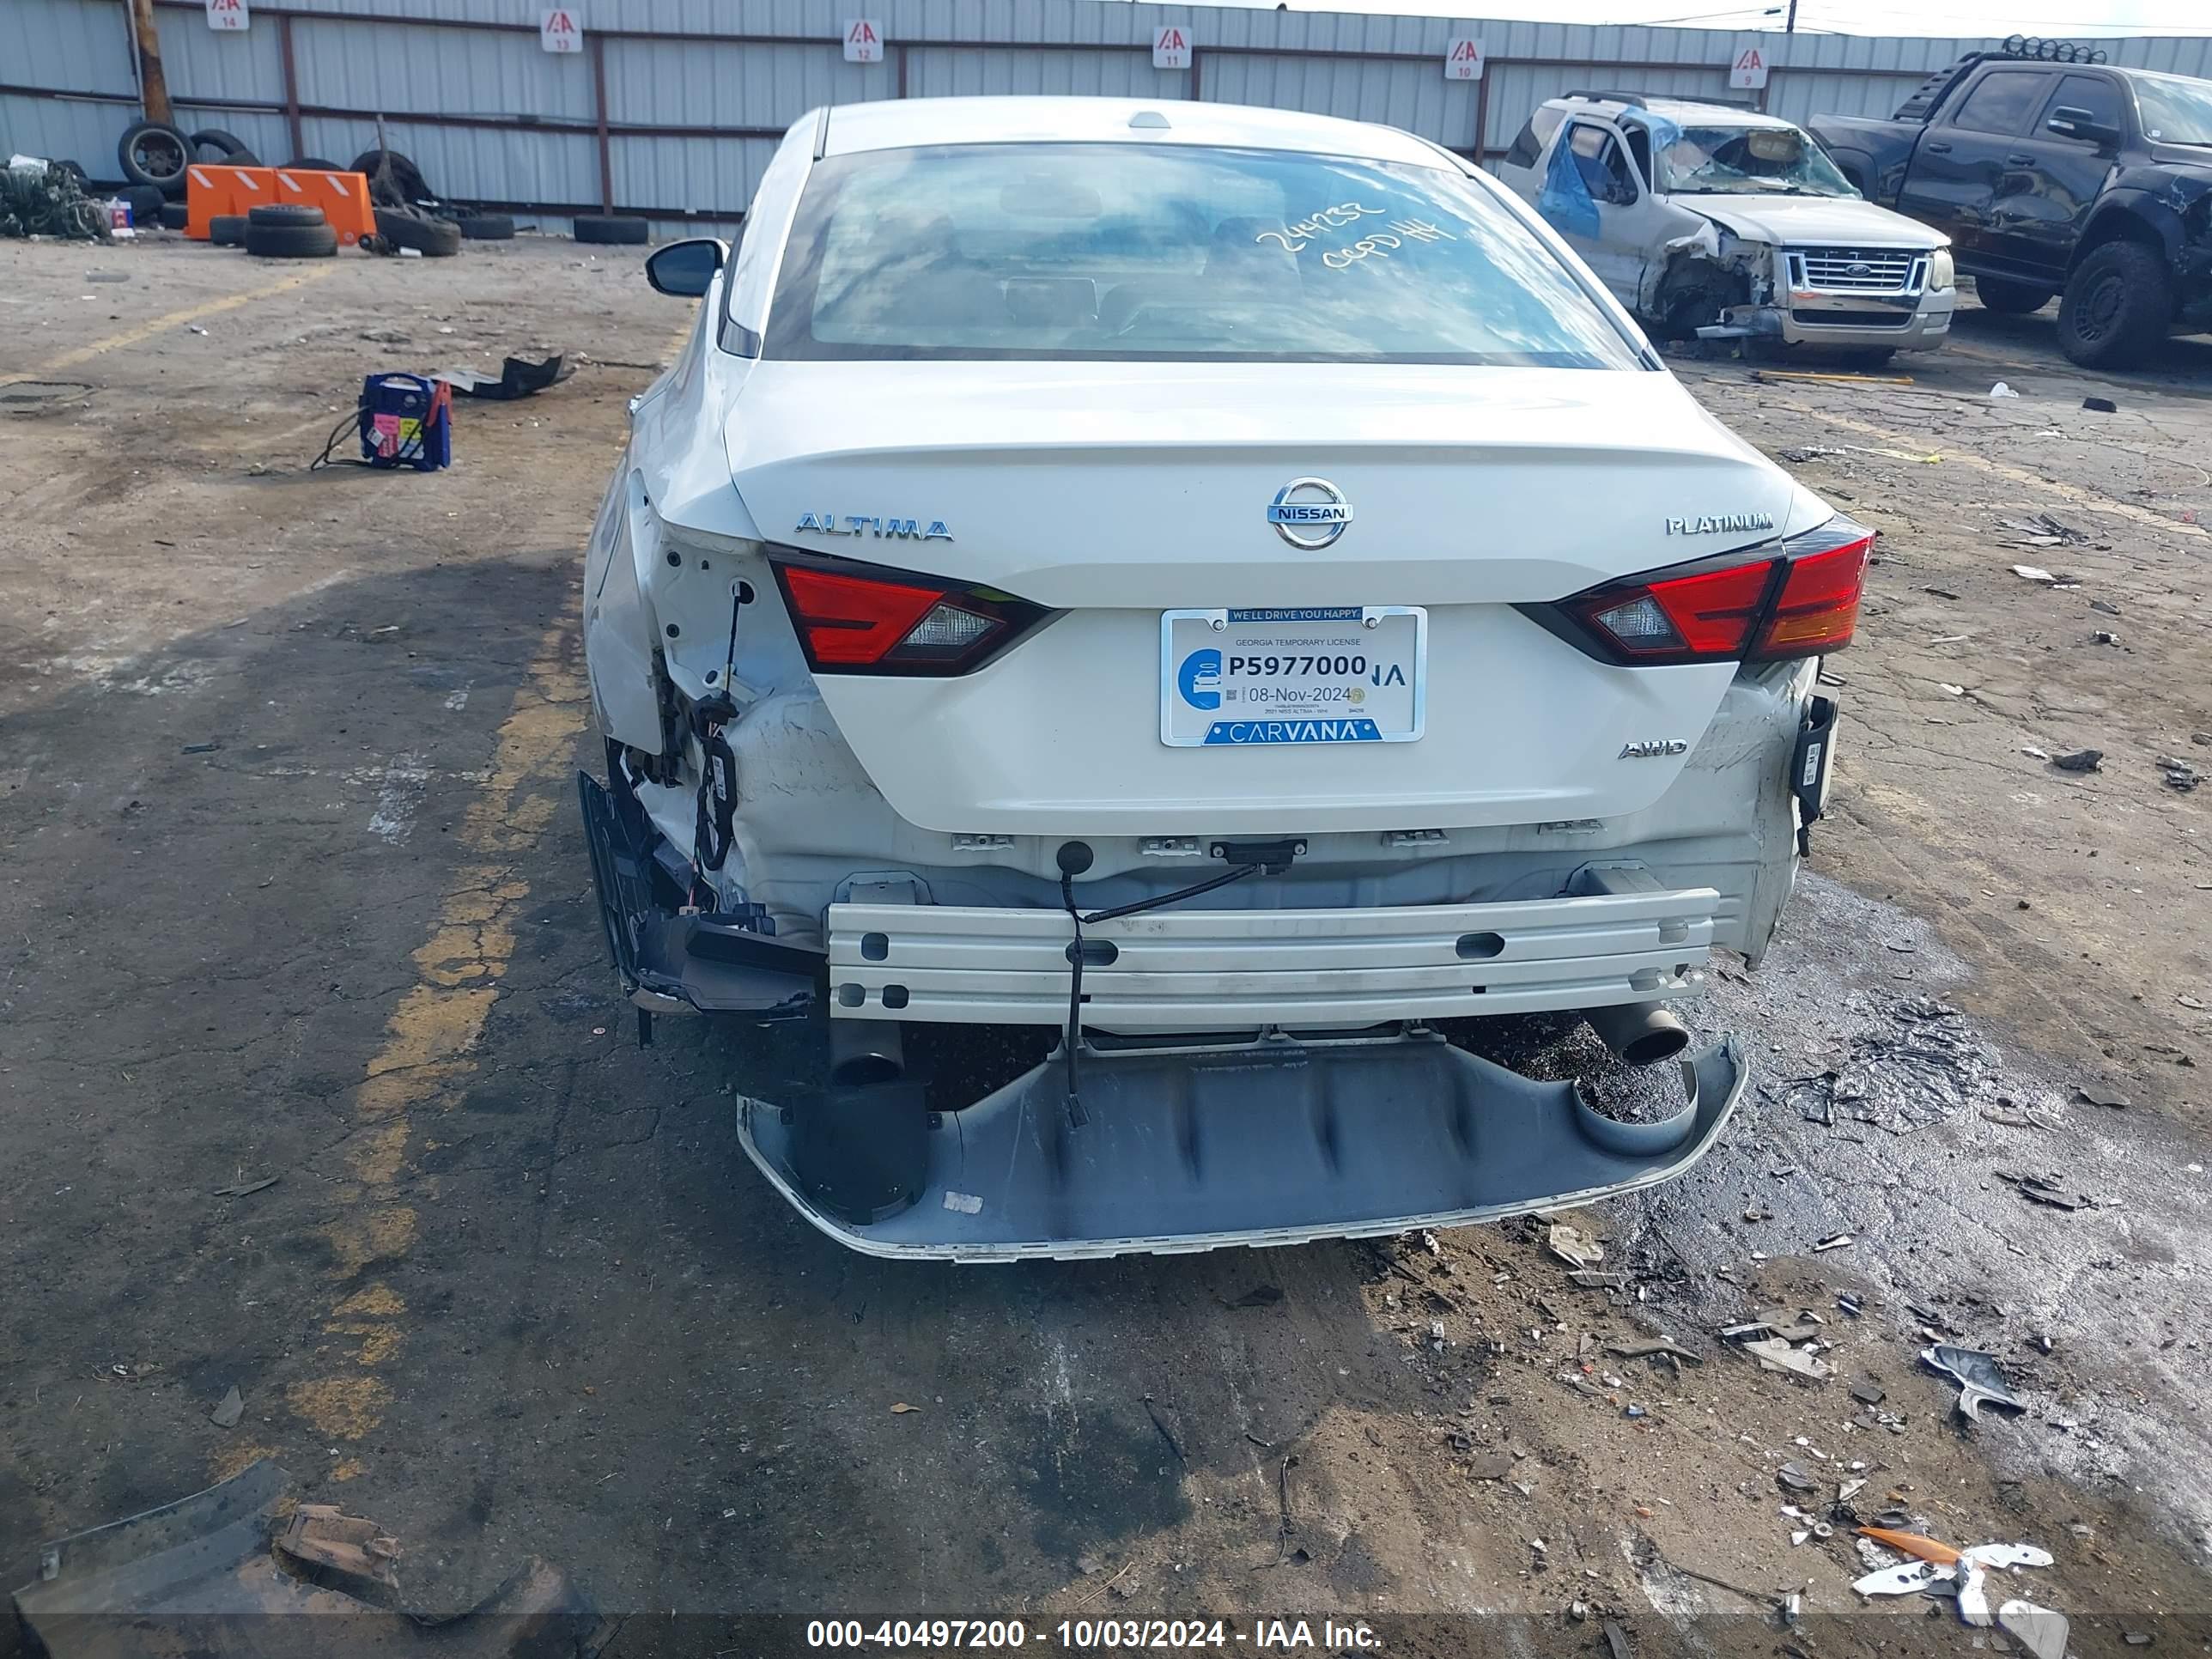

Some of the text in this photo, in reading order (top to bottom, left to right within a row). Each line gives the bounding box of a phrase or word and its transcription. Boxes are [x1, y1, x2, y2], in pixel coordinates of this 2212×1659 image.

[222, 16, 237, 28] 14
[1166, 55, 1179, 65] 11
[1458, 68, 1471, 77] 10
[1744, 76, 1753, 86] 9
[1277, 507, 1346, 520] NISSAN
[793, 513, 955, 542] ALTIMA
[1666, 513, 1774, 535] PLATINUM
[1232, 611, 1263, 620] WE'LL
[1265, 611, 1295, 619] DRIVE
[1298, 610, 1322, 619] YOU
[1229, 656, 1367, 676] P5977000
[1249, 688, 1352, 702] 08-Nov-2024
[1229, 720, 1358, 742] CARVANA
[1619, 738, 1687, 759] AWD
